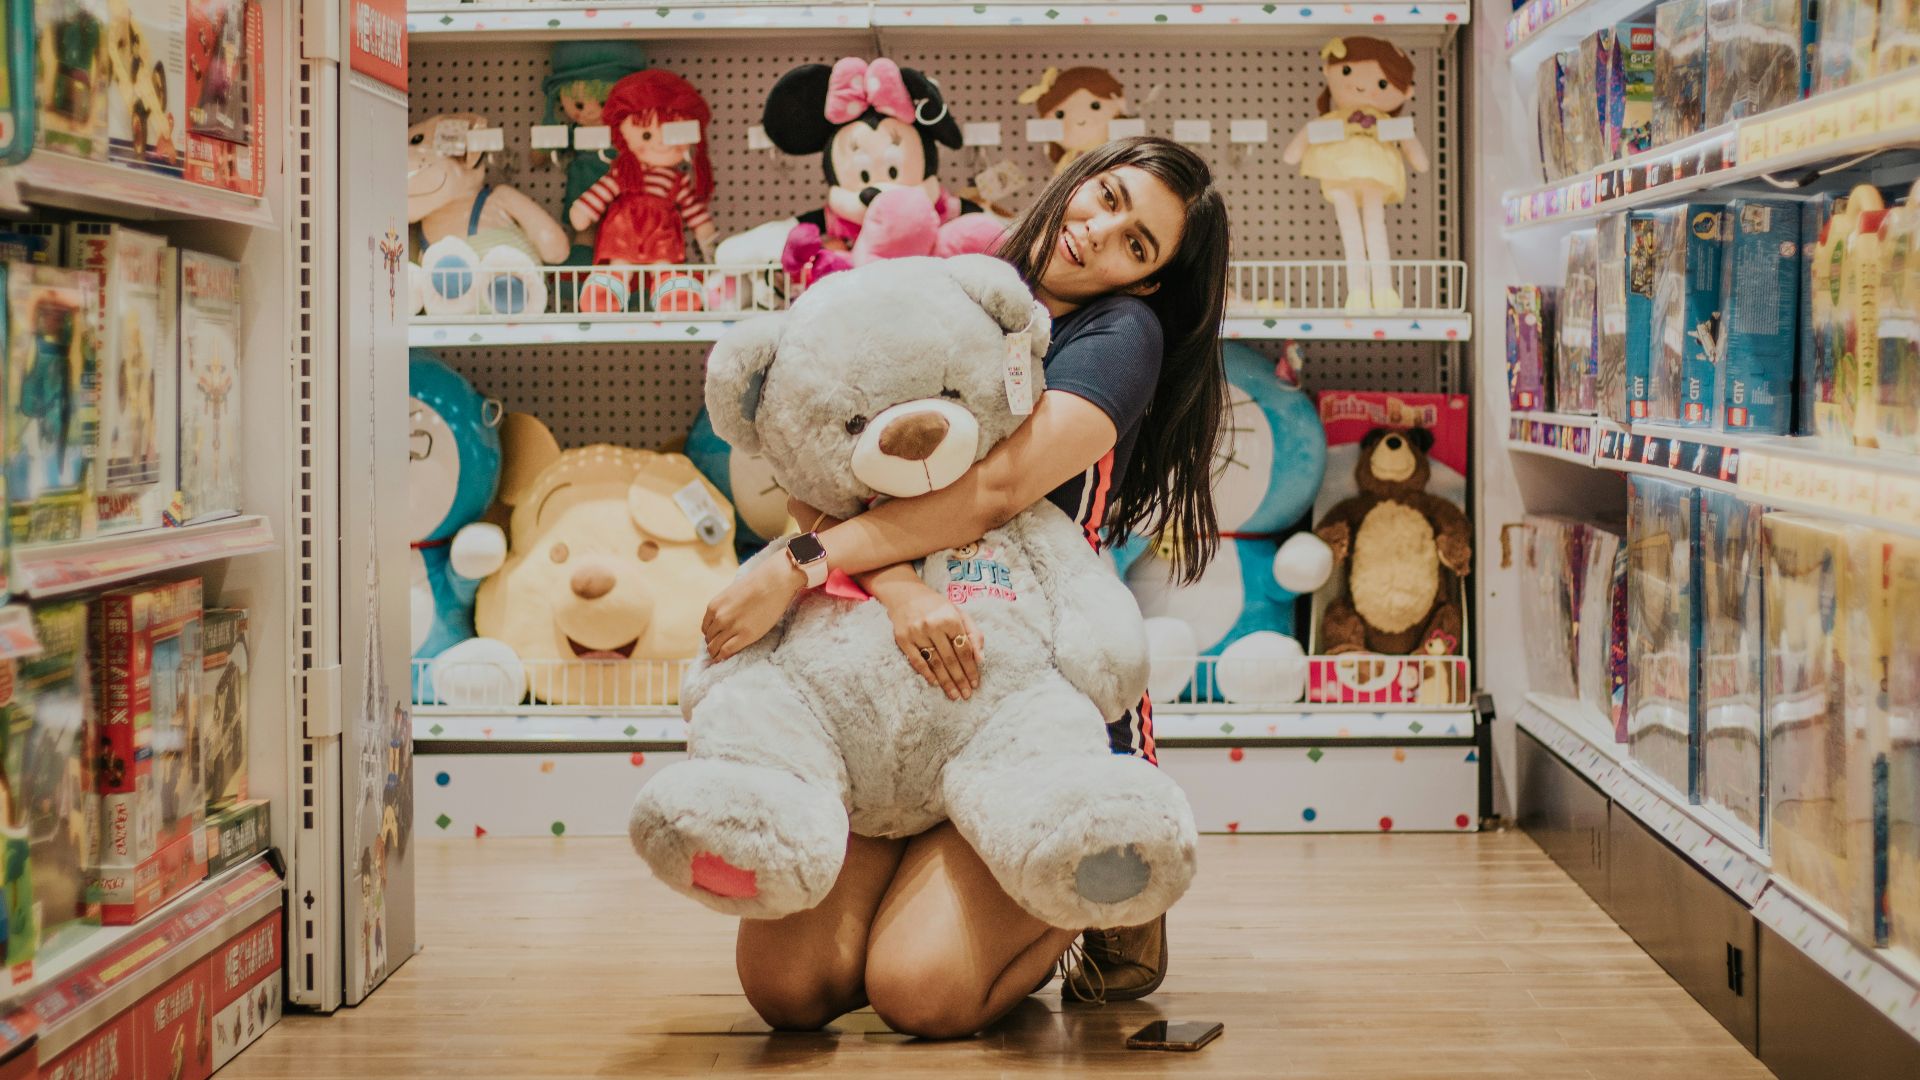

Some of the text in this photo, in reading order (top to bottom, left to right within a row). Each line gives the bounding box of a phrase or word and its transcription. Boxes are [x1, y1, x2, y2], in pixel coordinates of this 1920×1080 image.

[1630, 54, 1651, 64] 6-12
[1633, 376, 1644, 399] CITY
[1689, 377, 1700, 401] CITY
[1733, 380, 1745, 405] CITY
[947, 560, 1012, 589] CUTE
[109, 601, 128, 724] MECHANIX
